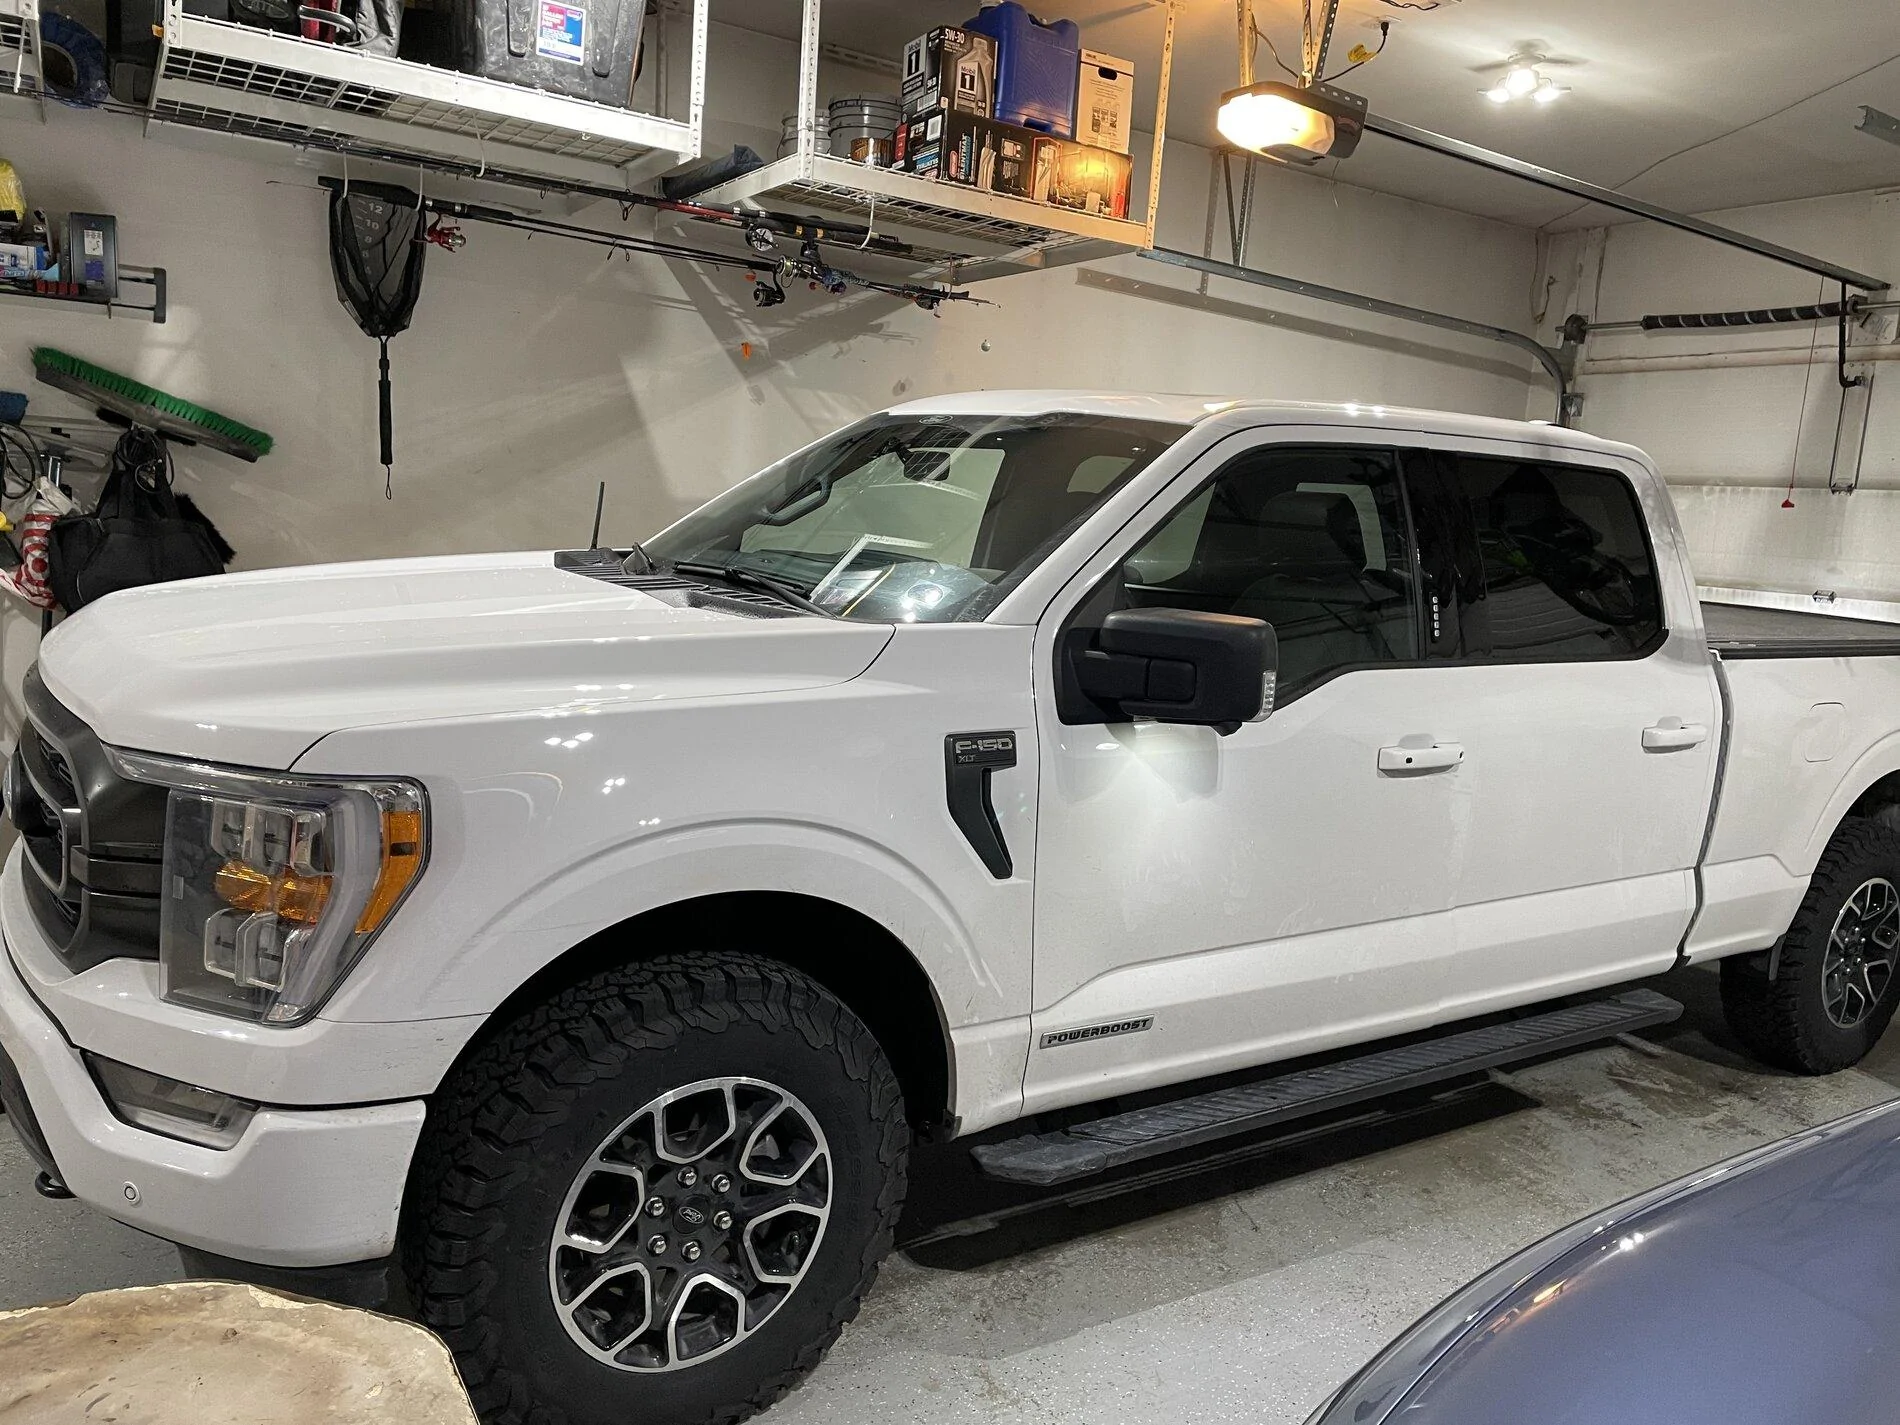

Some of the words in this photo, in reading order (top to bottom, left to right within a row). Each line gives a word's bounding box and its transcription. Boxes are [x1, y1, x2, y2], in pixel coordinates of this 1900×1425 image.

[945, 28, 965, 44] 5W-30
[961, 66, 976, 75] Mobil
[964, 75, 971, 89] 1
[955, 738, 1013, 753] F-150
[958, 754, 976, 763] XLT
[1047, 1018, 1150, 1044] POWERBOOST
